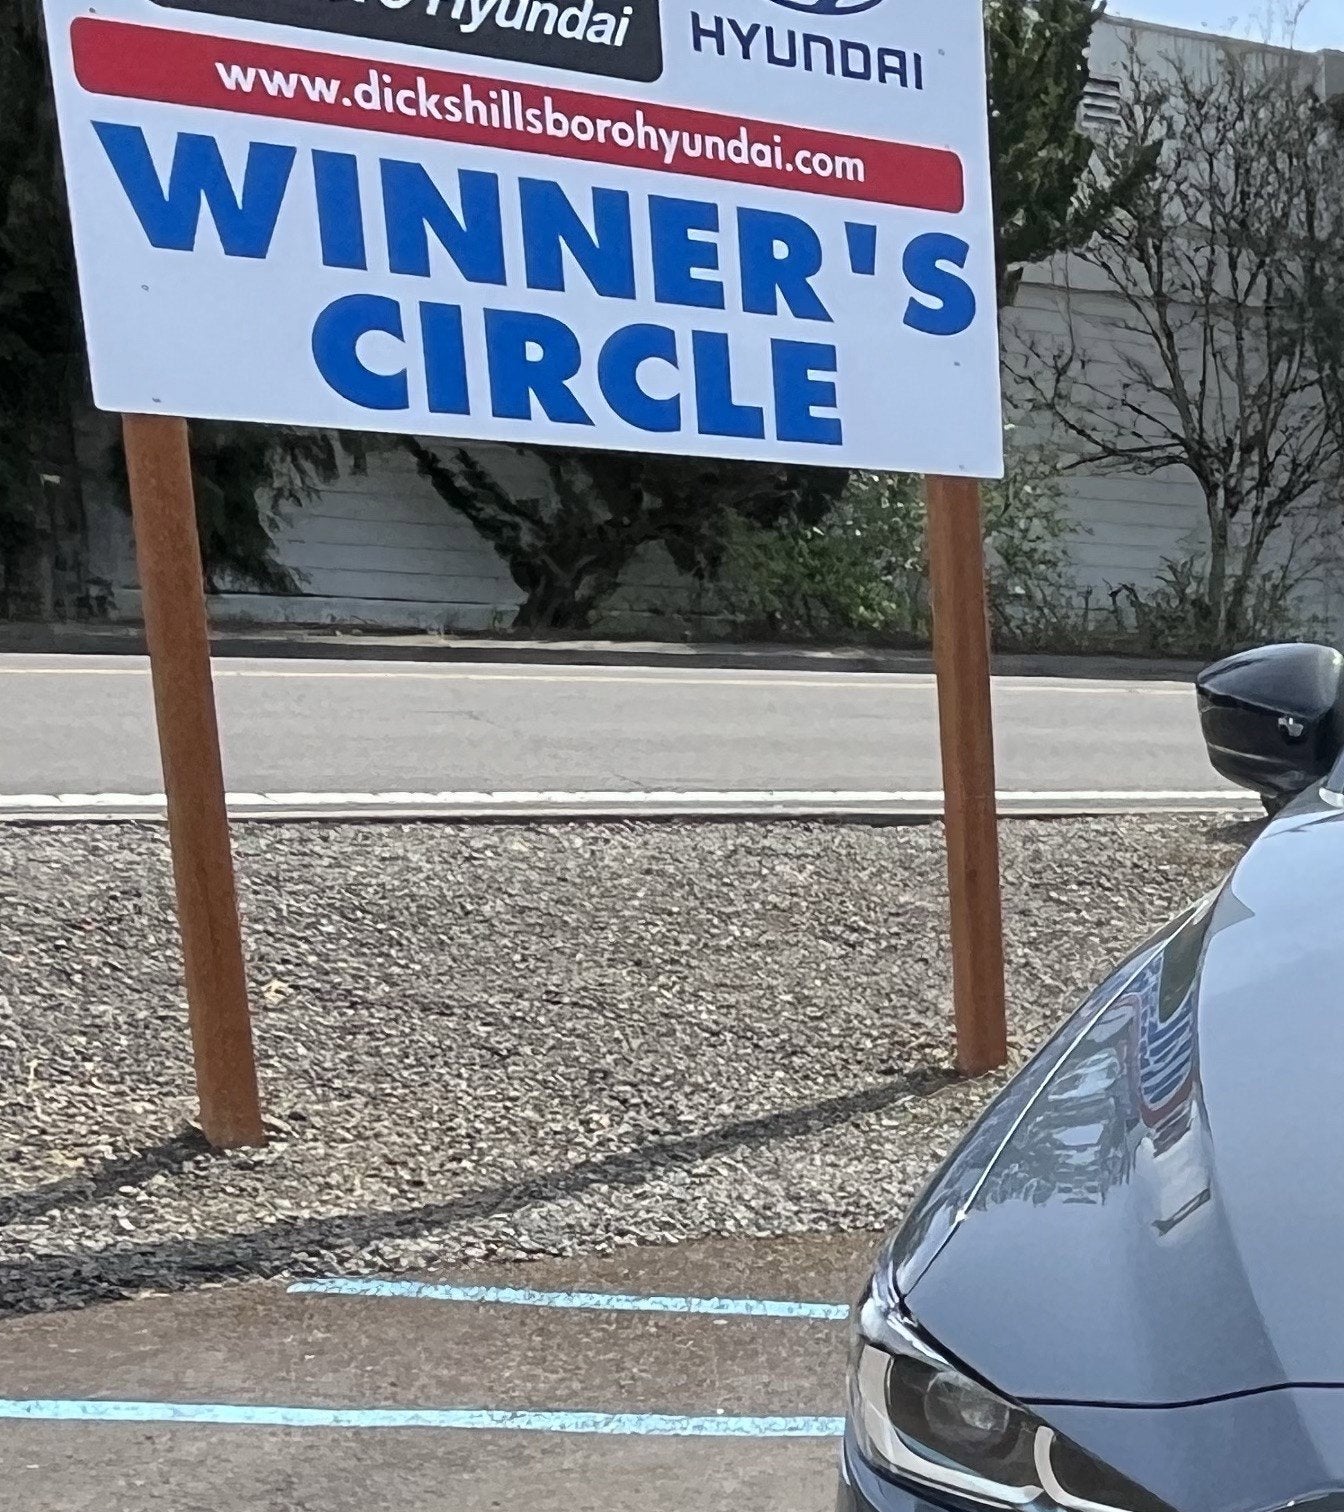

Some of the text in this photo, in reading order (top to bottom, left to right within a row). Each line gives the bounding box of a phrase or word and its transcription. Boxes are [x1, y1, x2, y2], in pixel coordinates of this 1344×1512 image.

[690, 10, 923, 90] HYUNDAI
[215, 61, 866, 184] www.dickshillsborohyundai.com
[92, 121, 976, 336] WINNER'S
[312, 294, 843, 446] CIRCLE
